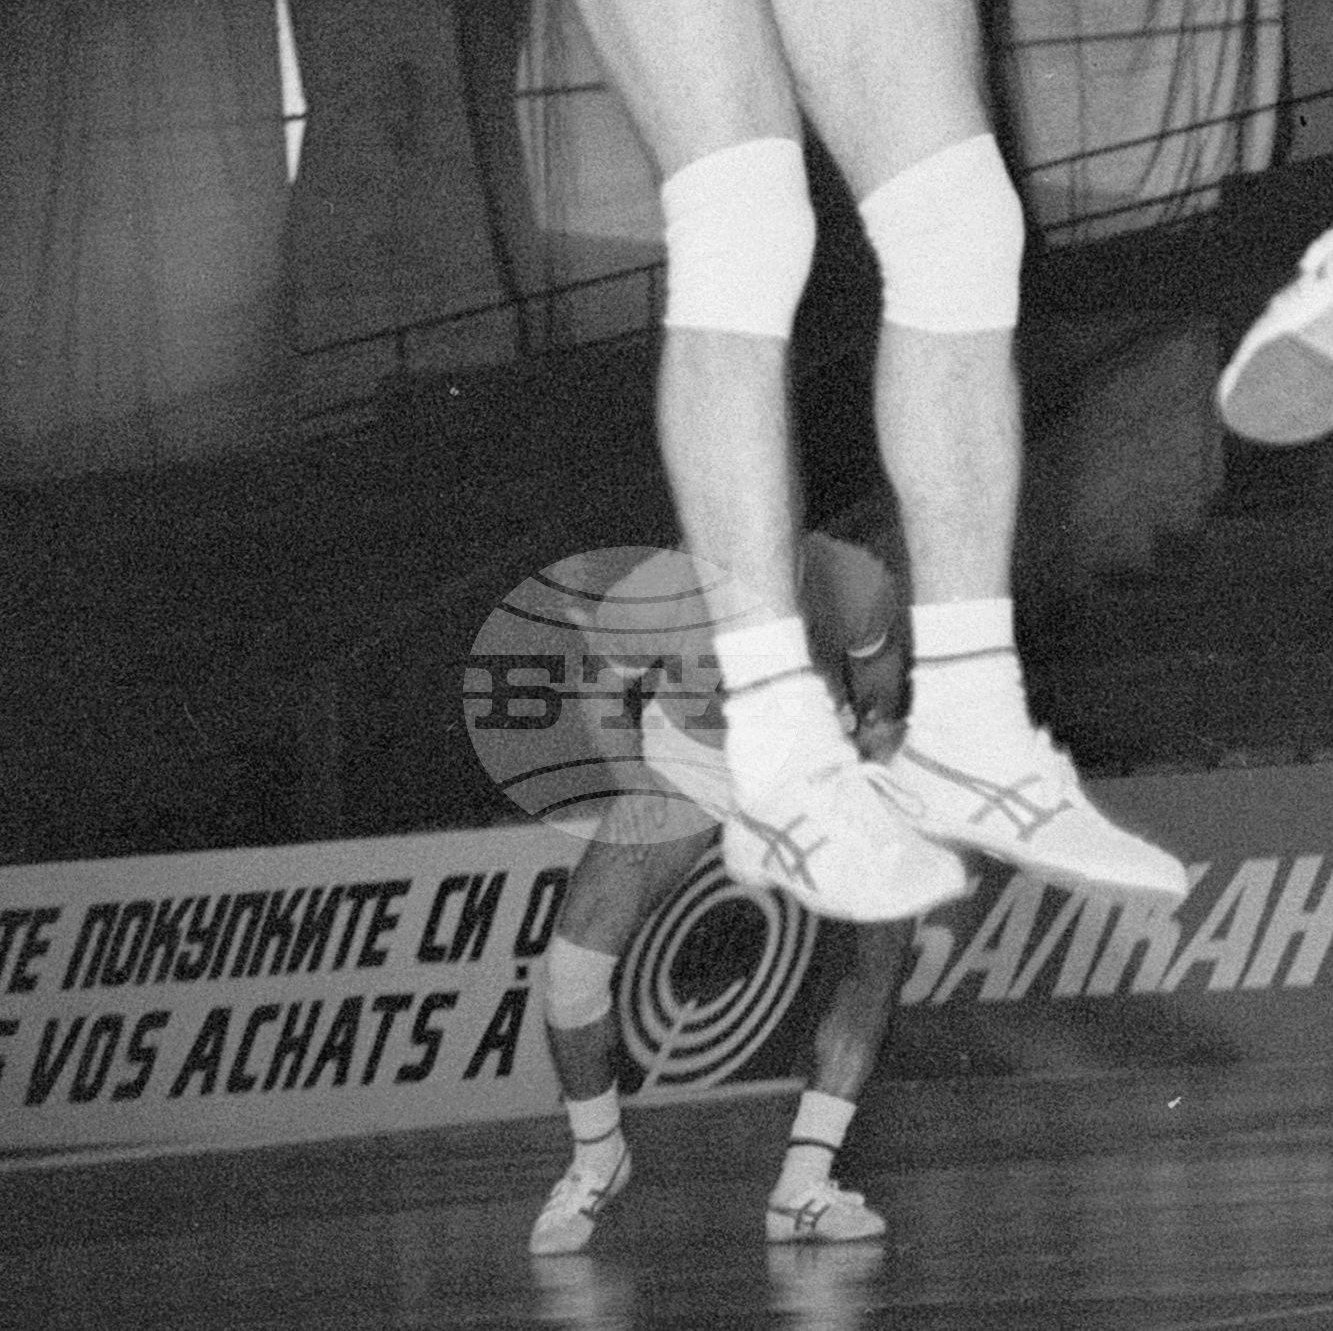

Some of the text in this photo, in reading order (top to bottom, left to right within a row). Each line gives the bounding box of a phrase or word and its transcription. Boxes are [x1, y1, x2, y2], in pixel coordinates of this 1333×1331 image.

[60, 877, 413, 992] ПОКУПКИТЕ
[416, 869, 509, 965] СИ
[24, 1009, 173, 1108] VOS
[165, 990, 460, 1101] ACHATS
